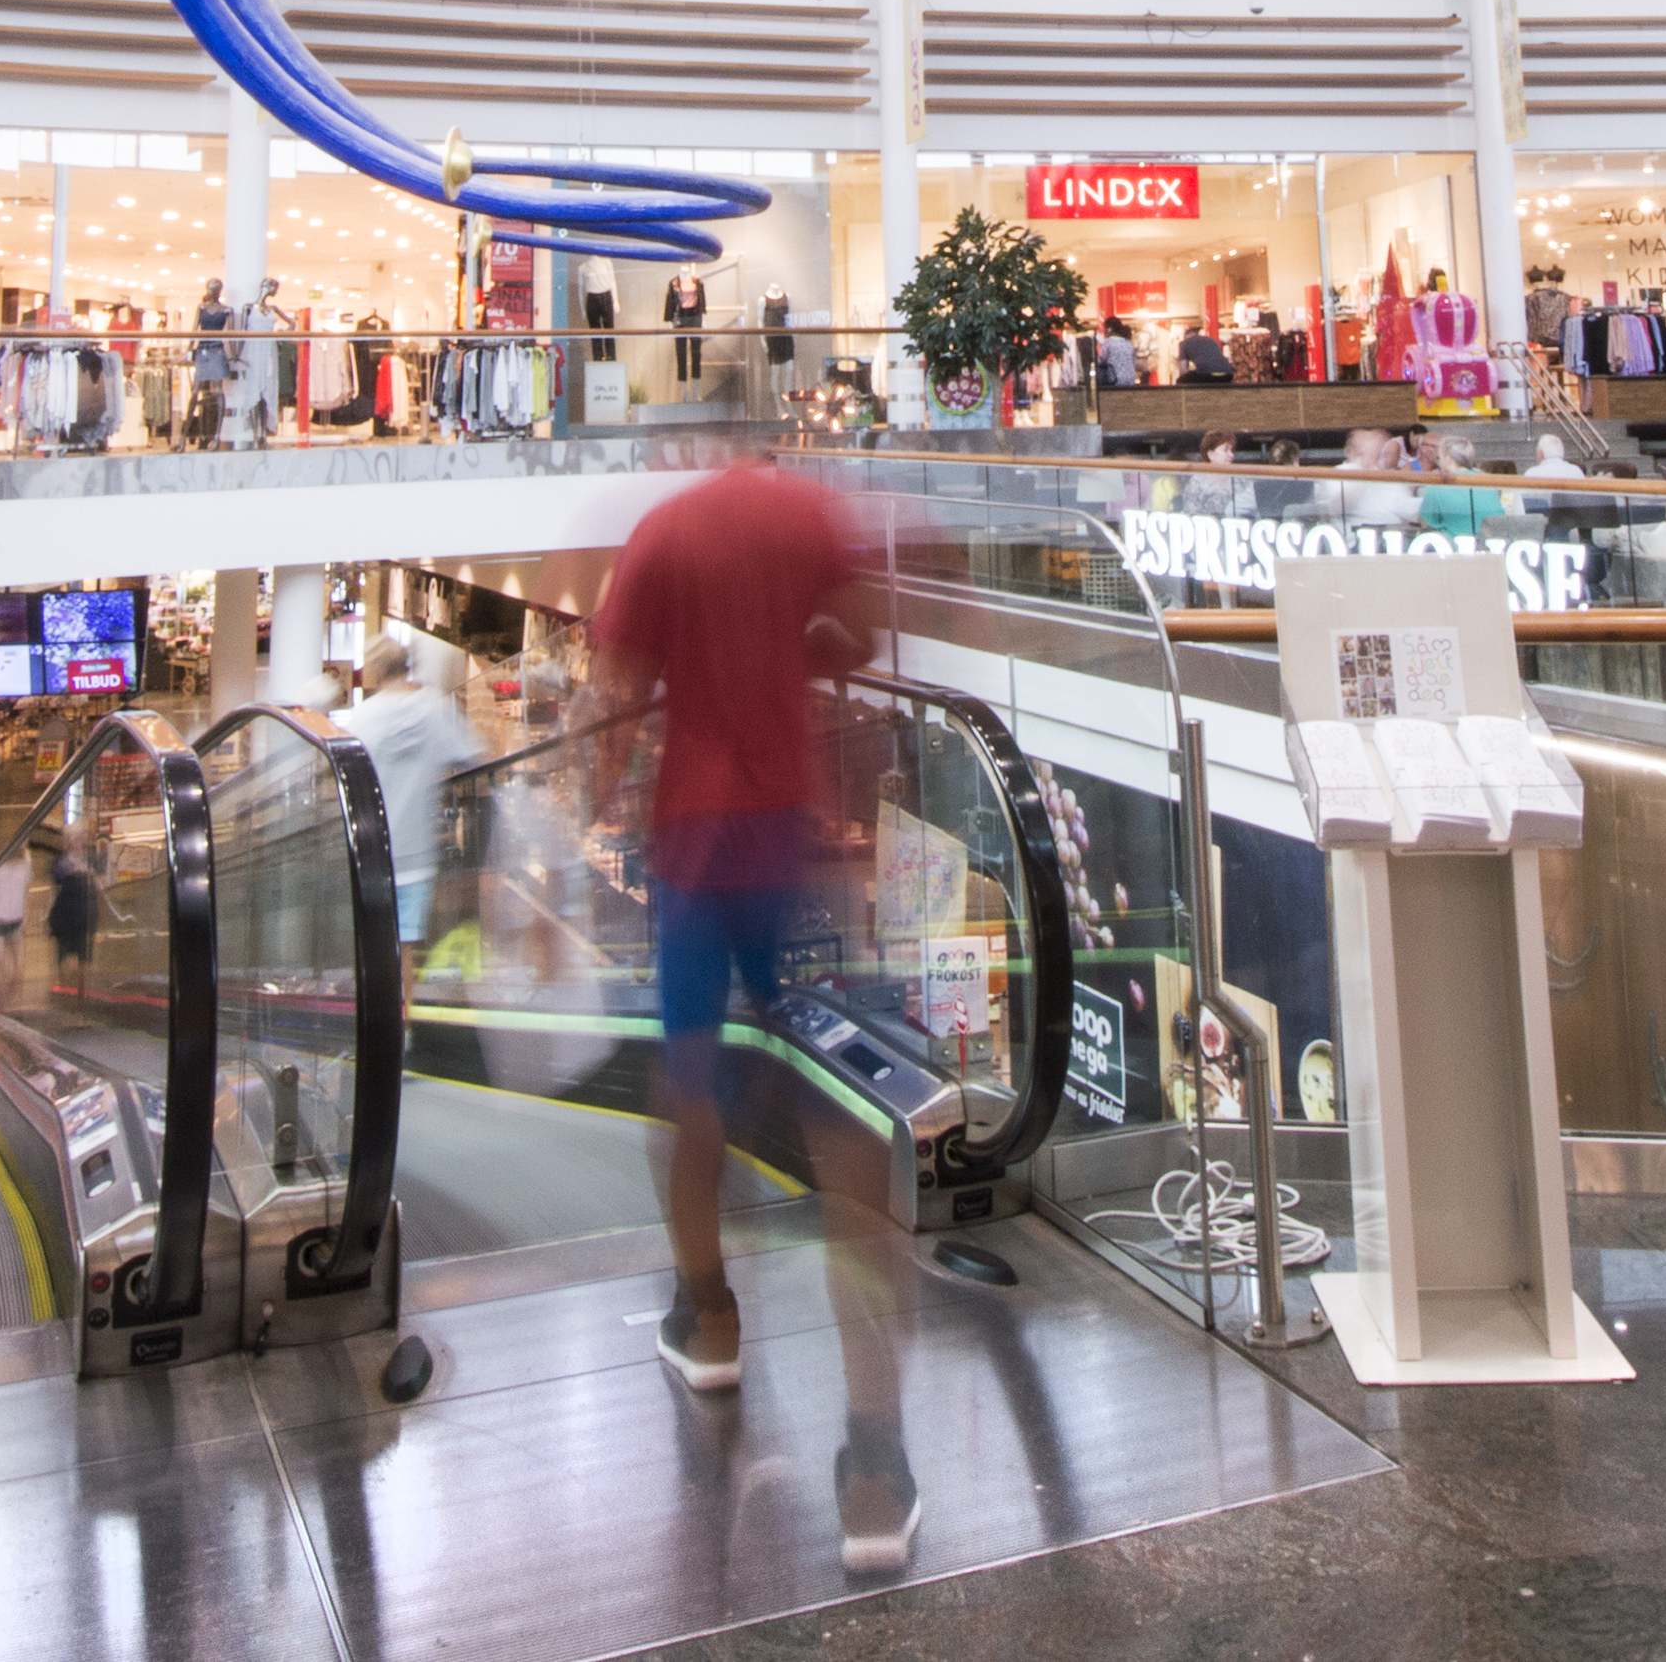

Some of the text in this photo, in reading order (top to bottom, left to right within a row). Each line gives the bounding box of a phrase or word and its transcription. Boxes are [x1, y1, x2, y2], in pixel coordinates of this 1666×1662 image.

[1044, 178, 1183, 207] LINDEX
[72, 674, 121, 690] TILBUD
[927, 966, 982, 982] FROKOST
[1073, 1001, 1113, 1047] oop
